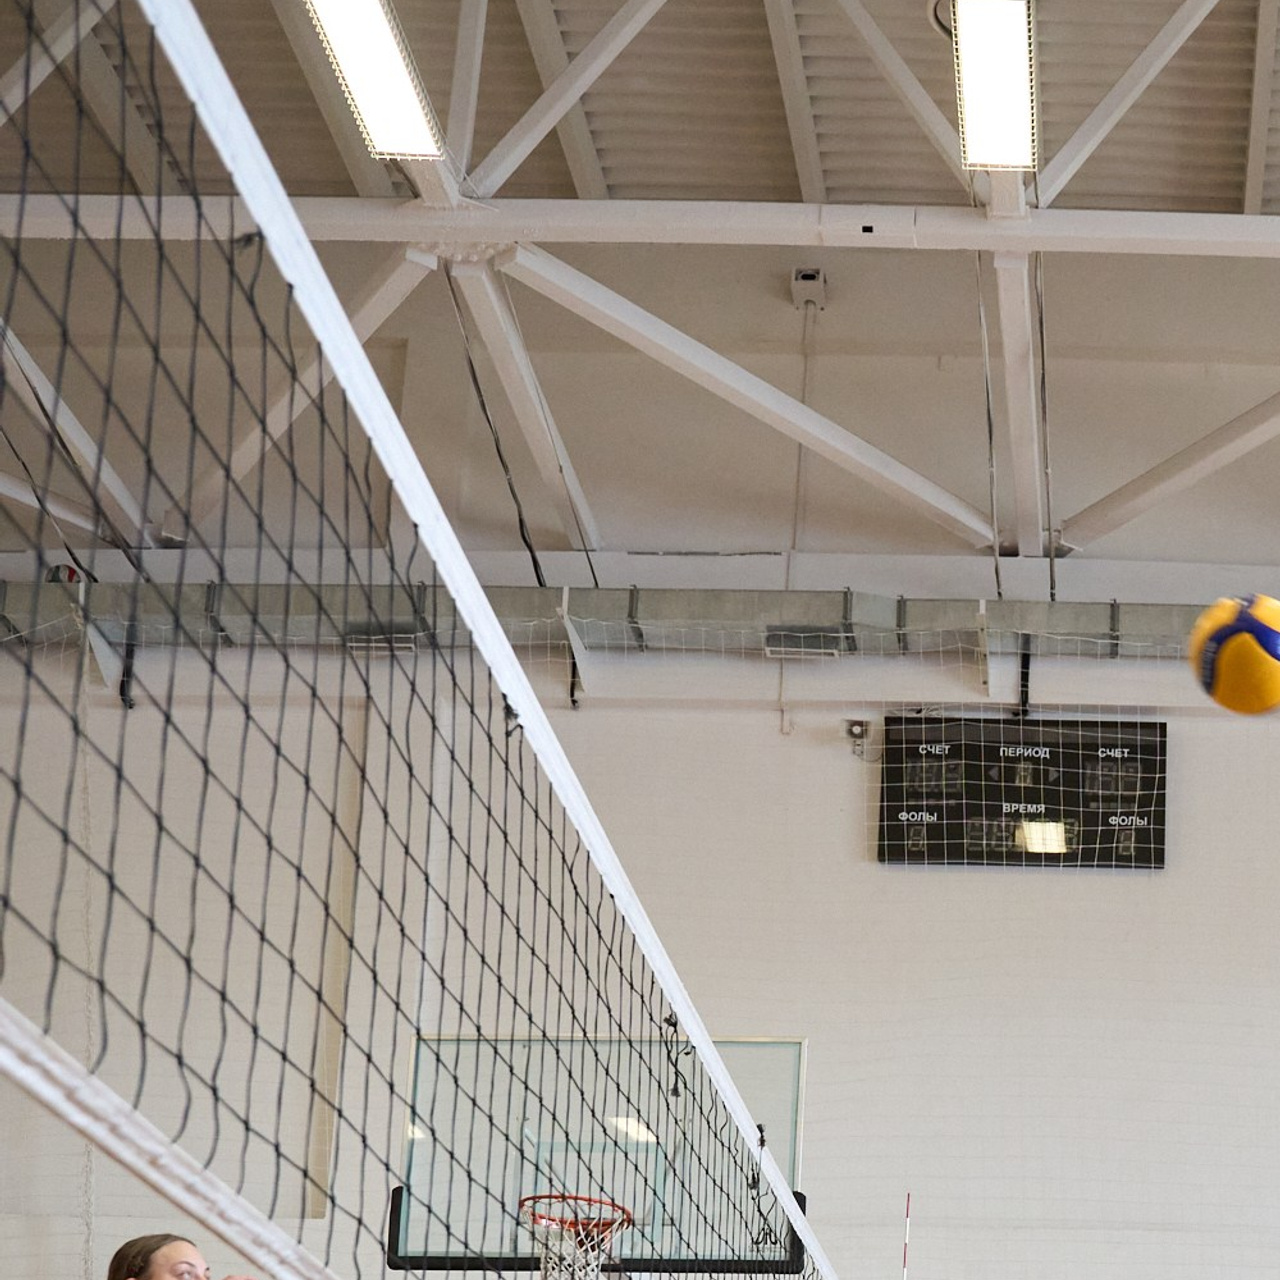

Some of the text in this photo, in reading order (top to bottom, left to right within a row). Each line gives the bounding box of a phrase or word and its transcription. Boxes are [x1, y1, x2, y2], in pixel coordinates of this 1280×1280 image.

[919, 744, 951, 755] СЧЕТ
[1000, 747, 1050, 759] ПЕРИОД
[1098, 747, 1130, 758] СЧЕТ
[1003, 803, 1046, 814] ВРЕМЯ
[898, 811, 937, 822] ФОЛЫ
[1108, 815, 1148, 826] ФОЛЫ
